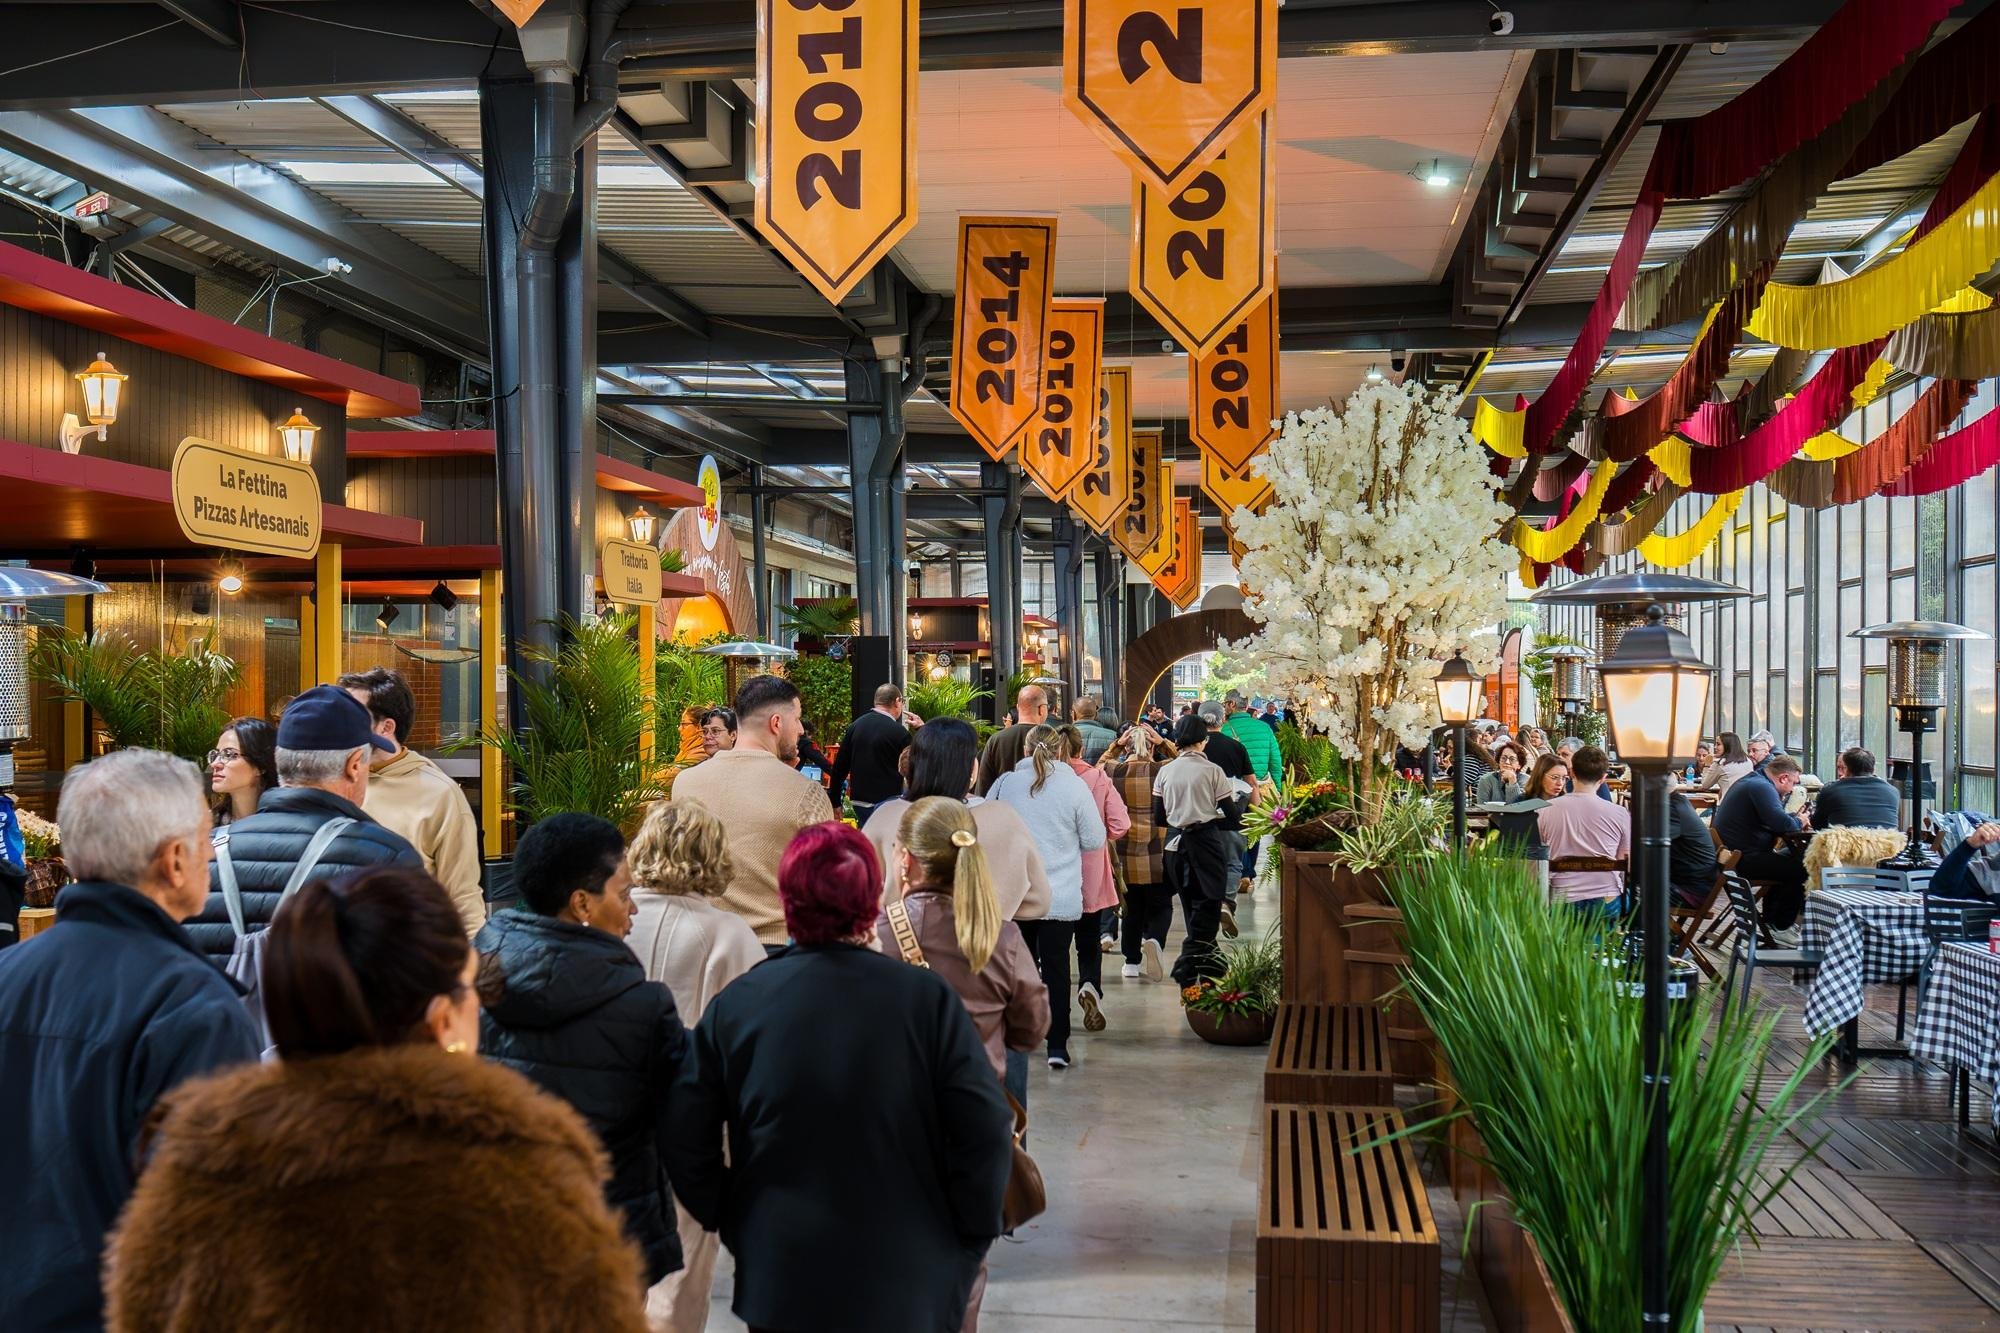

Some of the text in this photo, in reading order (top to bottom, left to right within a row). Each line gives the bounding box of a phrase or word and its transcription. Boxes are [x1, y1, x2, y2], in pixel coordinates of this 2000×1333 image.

[794, 0, 862, 211] 201
[1166, 149, 1226, 280] 20
[976, 251, 1029, 406] 2014
[1211, 318, 1249, 430] 201
[1039, 330, 1075, 458] 2010
[193, 495, 310, 538] Pizzas Artesanais
[219, 463, 288, 500] La Fettina
[620, 549, 648, 570] Trattoria
